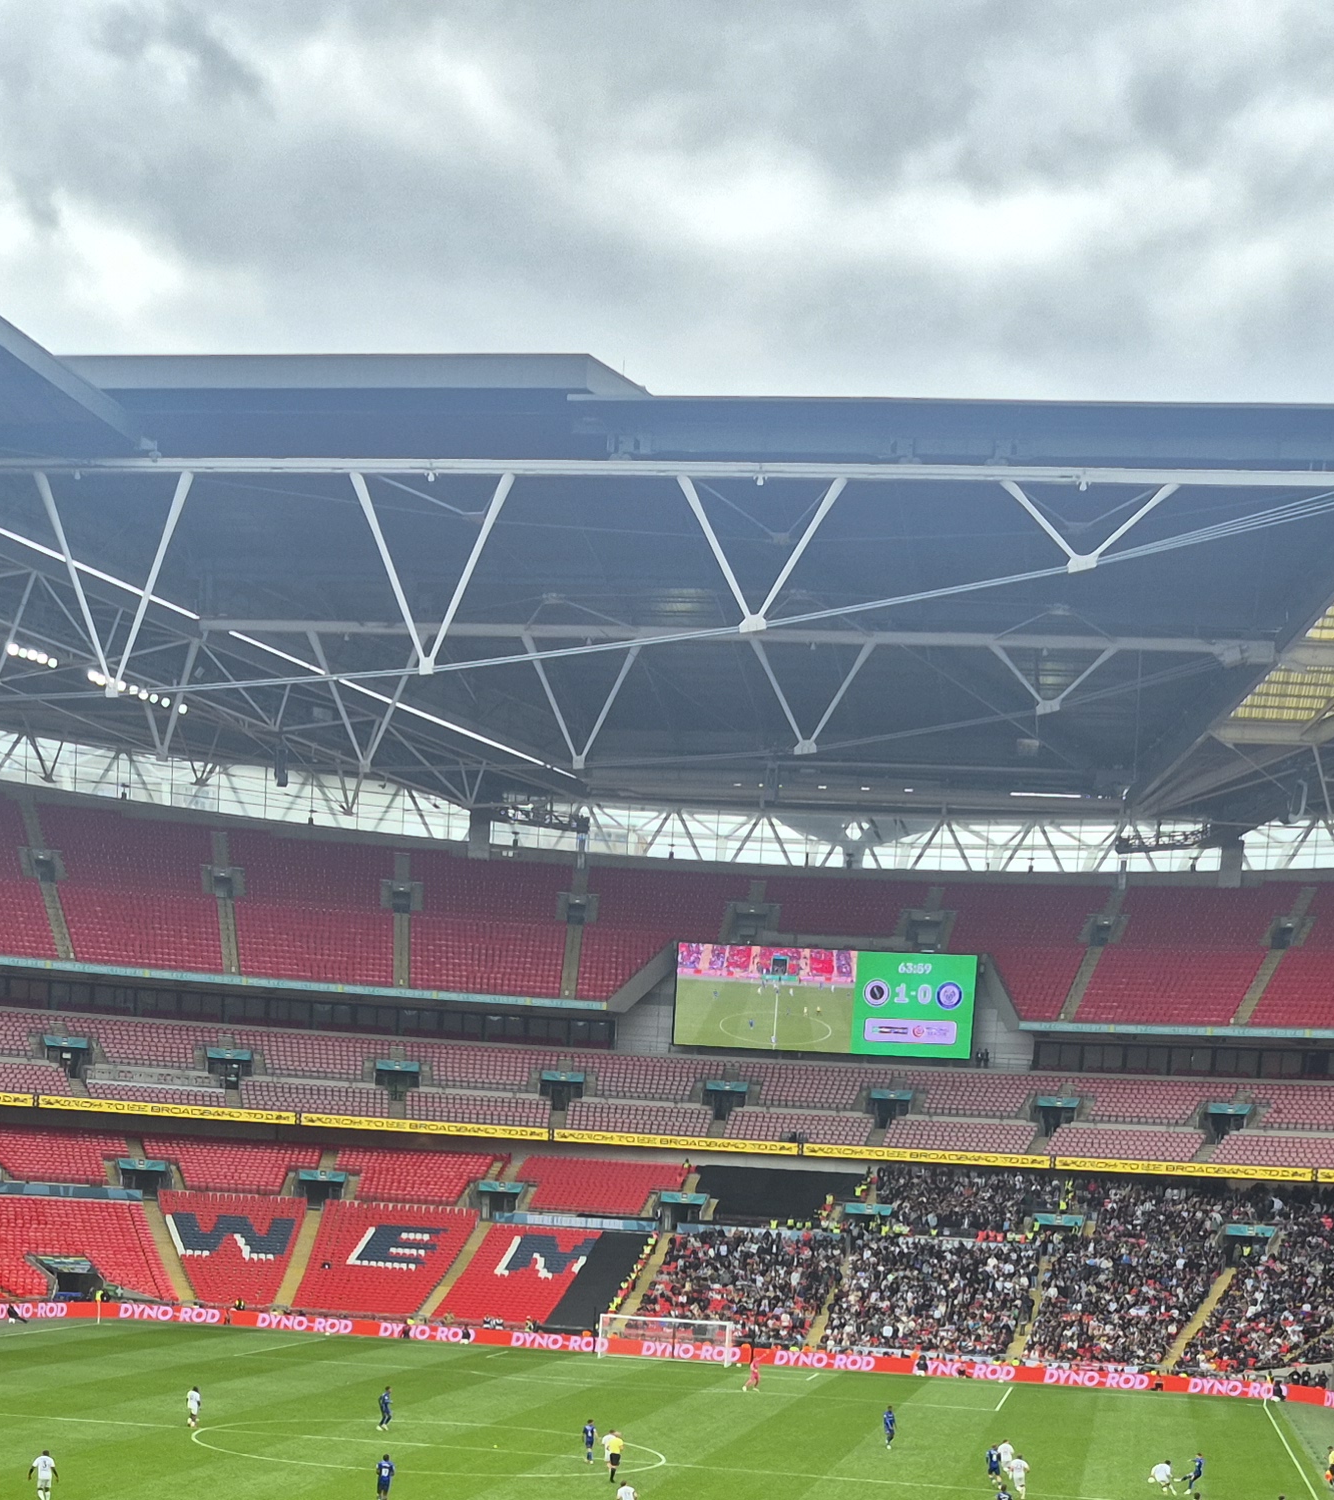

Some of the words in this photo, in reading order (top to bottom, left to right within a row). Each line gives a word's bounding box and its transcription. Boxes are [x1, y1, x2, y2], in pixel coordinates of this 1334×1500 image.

[119, 1302, 221, 1323] DYNO-ROD
[257, 1313, 353, 1334] DYNO-ROD
[511, 1332, 609, 1352] DYNO-ROD
[641, 1341, 741, 1362] DYNO-ROD
[774, 1350, 875, 1370] DYNO-ROD
[1044, 1369, 1149, 1389] DYNO-ROD
